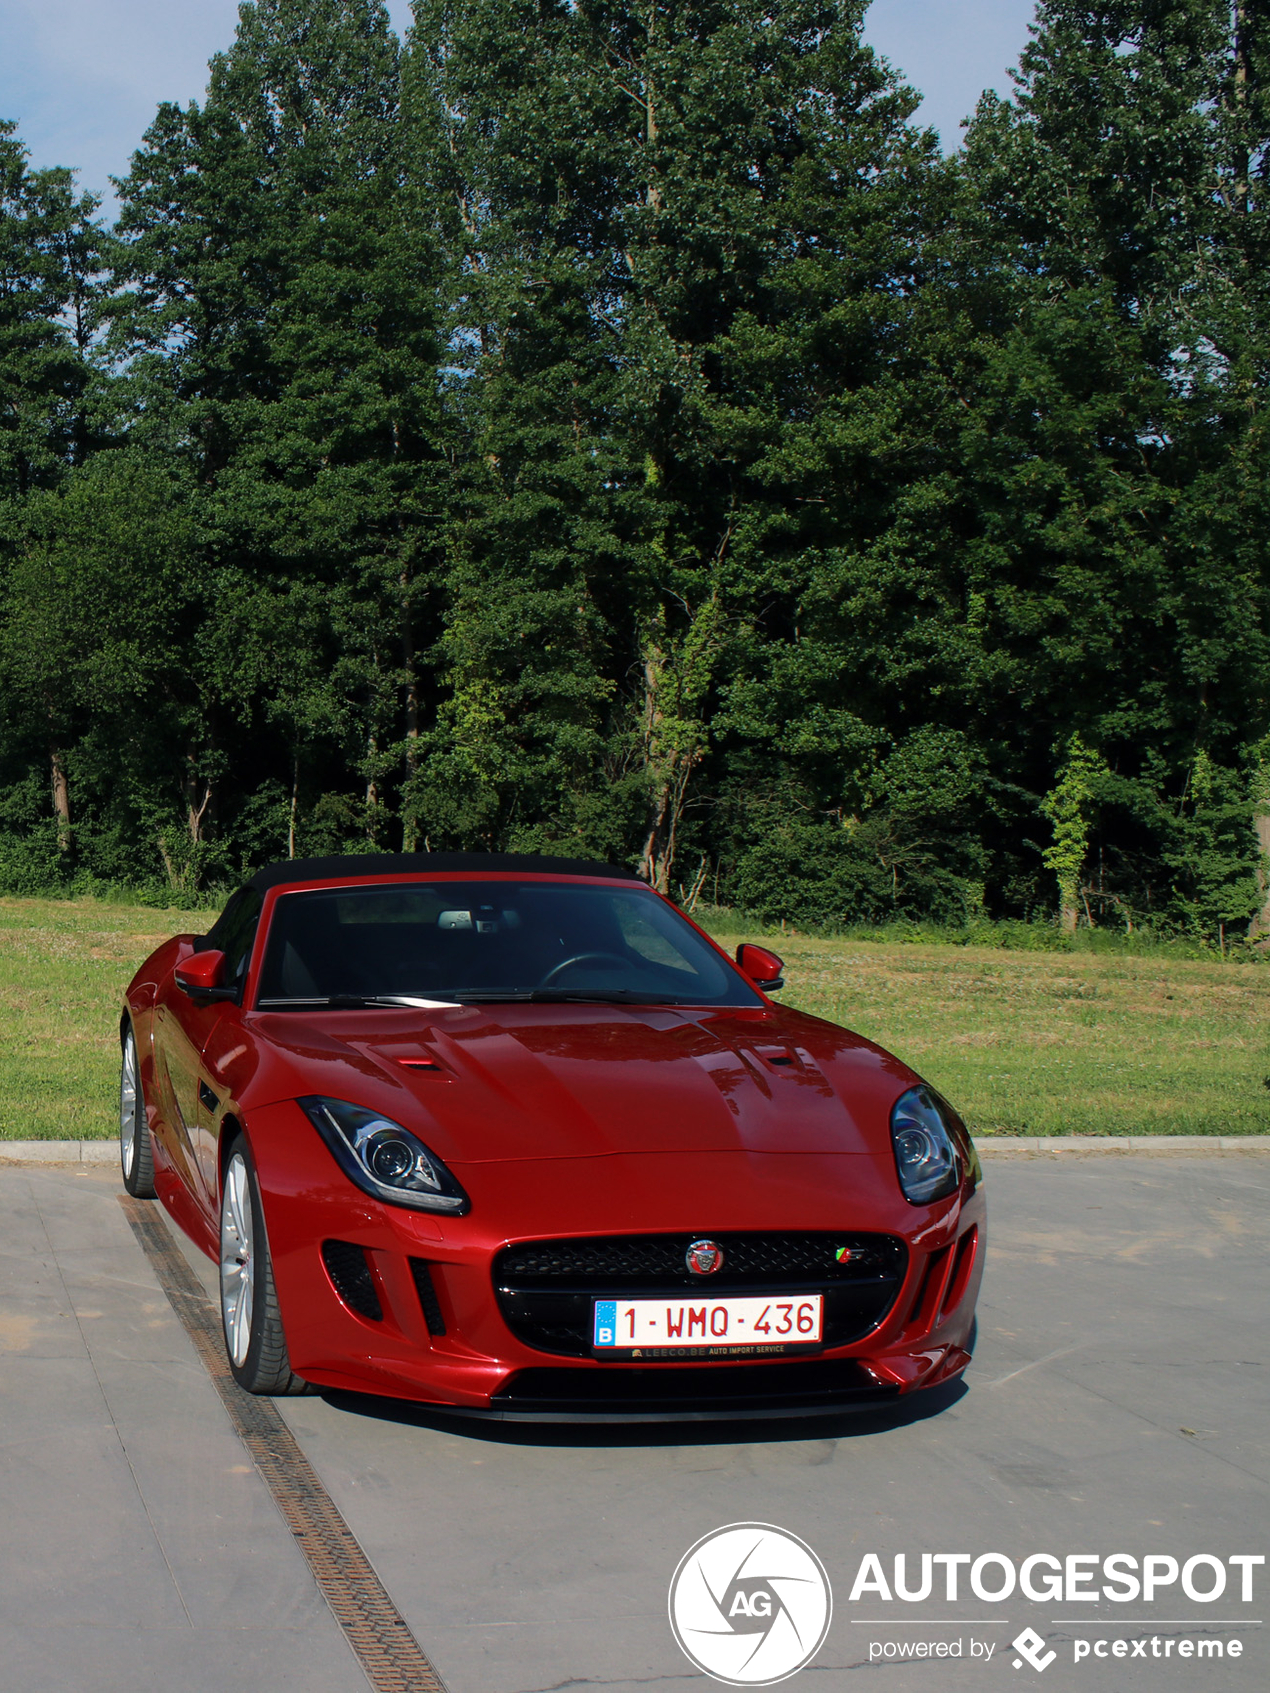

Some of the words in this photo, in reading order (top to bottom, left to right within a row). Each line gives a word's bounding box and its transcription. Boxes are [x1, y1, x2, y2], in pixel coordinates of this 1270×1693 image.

[599, 1328, 612, 1342] B
[646, 1347, 706, 1357] LEECO.BE
[709, 1346, 728, 1355] AUTO
[729, 1346, 754, 1354] IMPORT
[756, 1345, 785, 1353] SERVICE
